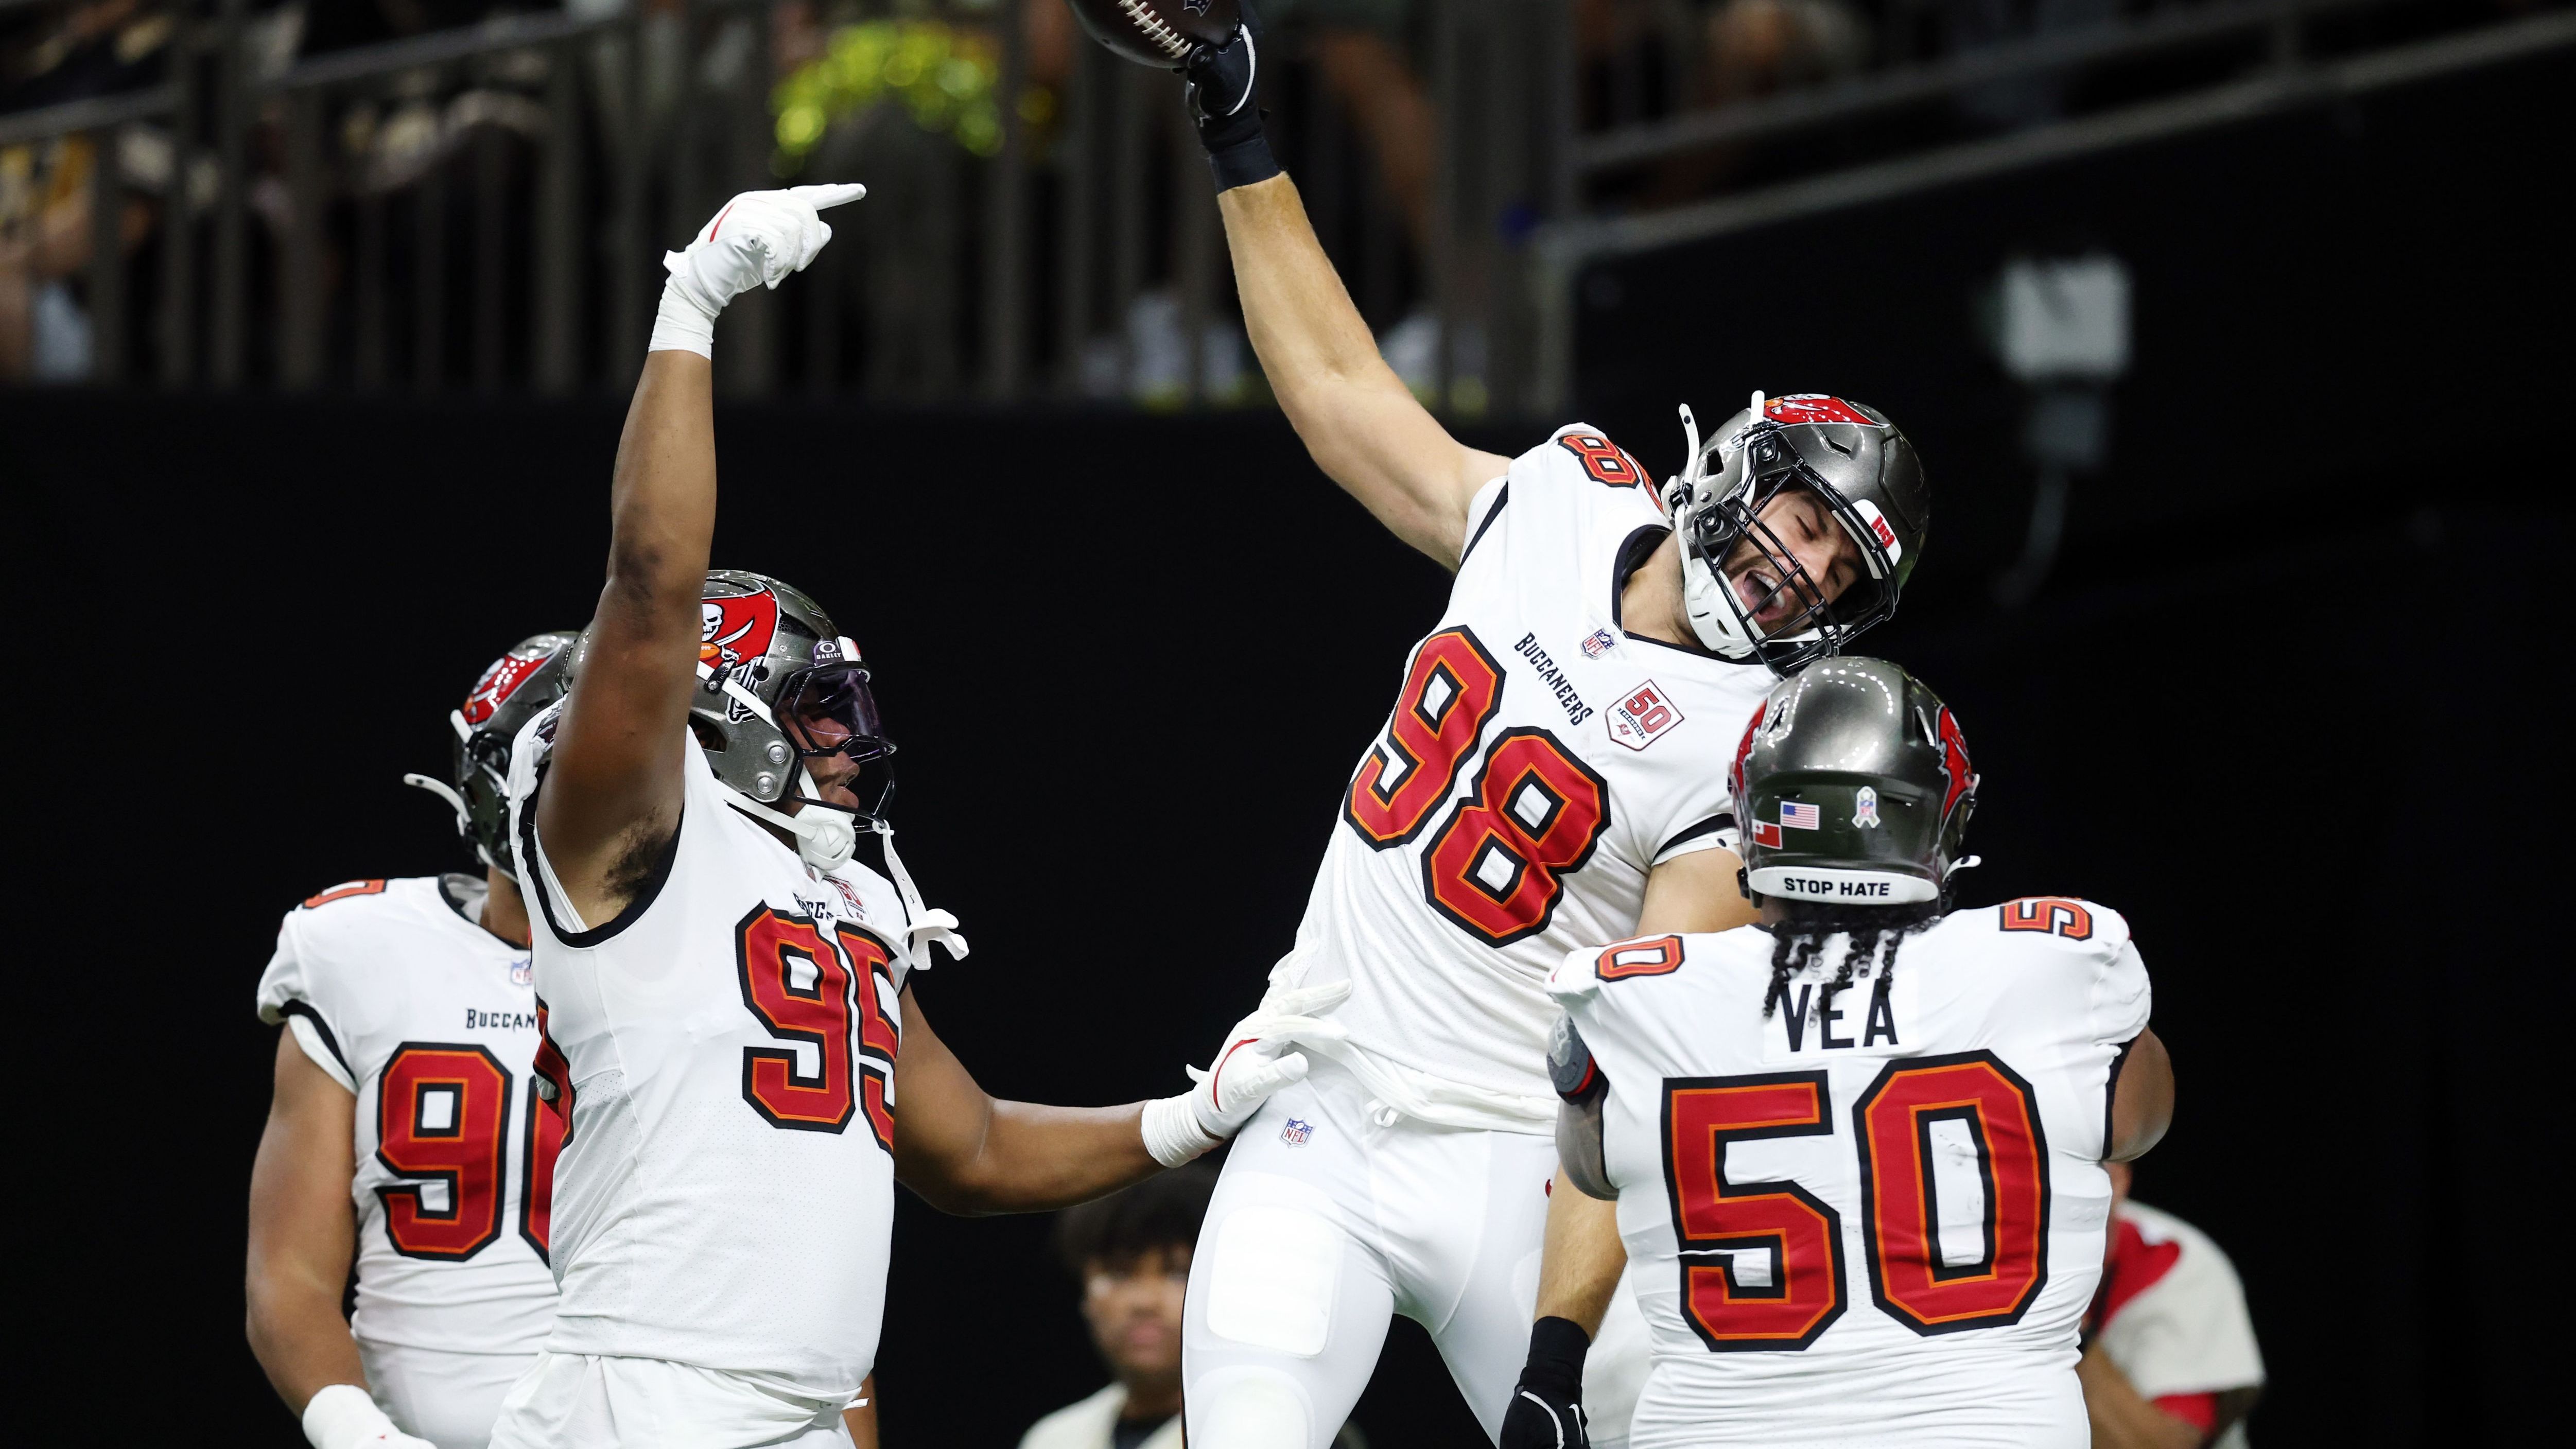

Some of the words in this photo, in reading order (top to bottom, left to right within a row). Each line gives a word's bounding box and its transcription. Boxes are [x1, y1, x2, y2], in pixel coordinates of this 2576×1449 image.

[1584, 636, 1604, 655] NFL
[1513, 631, 1594, 726] BUCCANEERS
[1625, 687, 1672, 734] 50
[1344, 624, 1611, 948] 98
[1784, 877, 1834, 894] STOP
[1840, 882, 1890, 896] HATE
[1595, 935, 1685, 983] 0
[735, 899, 901, 1161] 95
[1778, 979, 1899, 1052] VEA
[1284, 1128, 1304, 1143] NFL
[1661, 1049, 2051, 1352] 50
